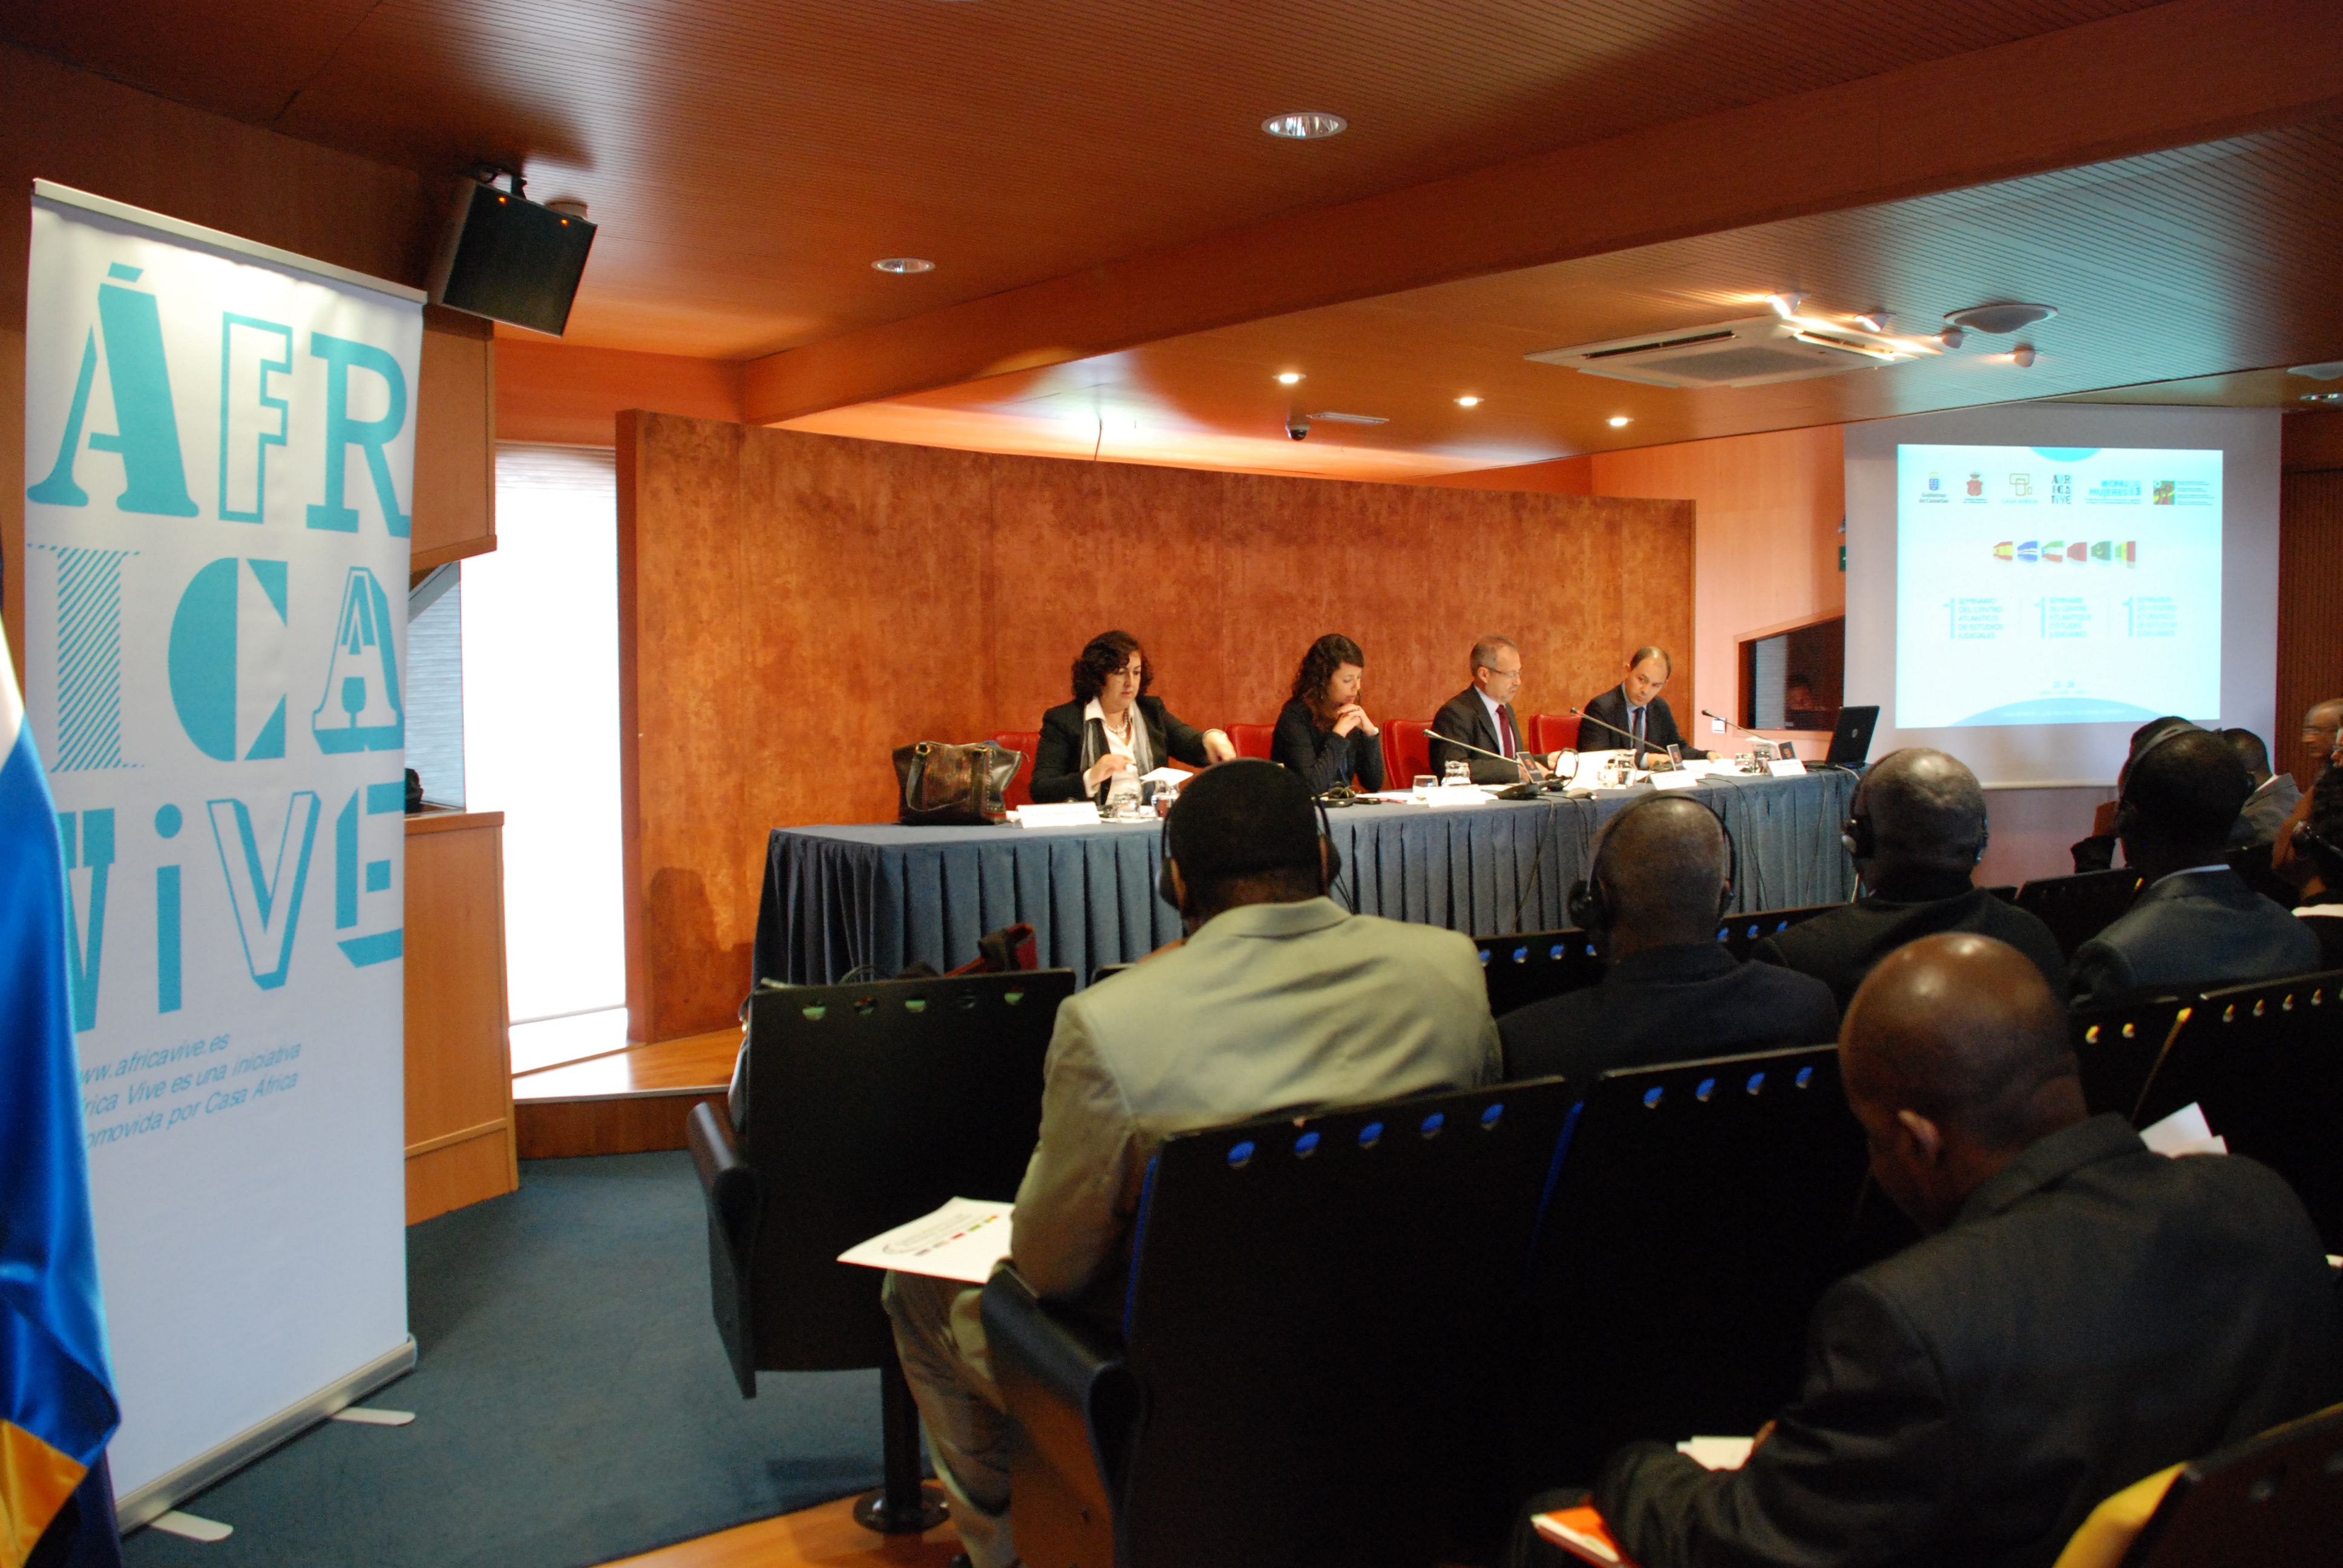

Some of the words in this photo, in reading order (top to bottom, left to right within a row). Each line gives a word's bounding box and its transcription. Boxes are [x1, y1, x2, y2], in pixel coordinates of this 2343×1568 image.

[2089, 488, 2128, 497] MUJERES
[81, 1033, 230, 1085] ww.africavive.es
[84, 1094, 119, 1116] rica
[128, 1080, 166, 1105] Vive
[171, 1074, 193, 1093] es
[196, 1065, 228, 1086] una
[231, 1042, 302, 1076] iniciativa
[87, 1110, 164, 1148] omovida
[166, 1102, 202, 1131] por
[205, 1088, 248, 1114] Casa
